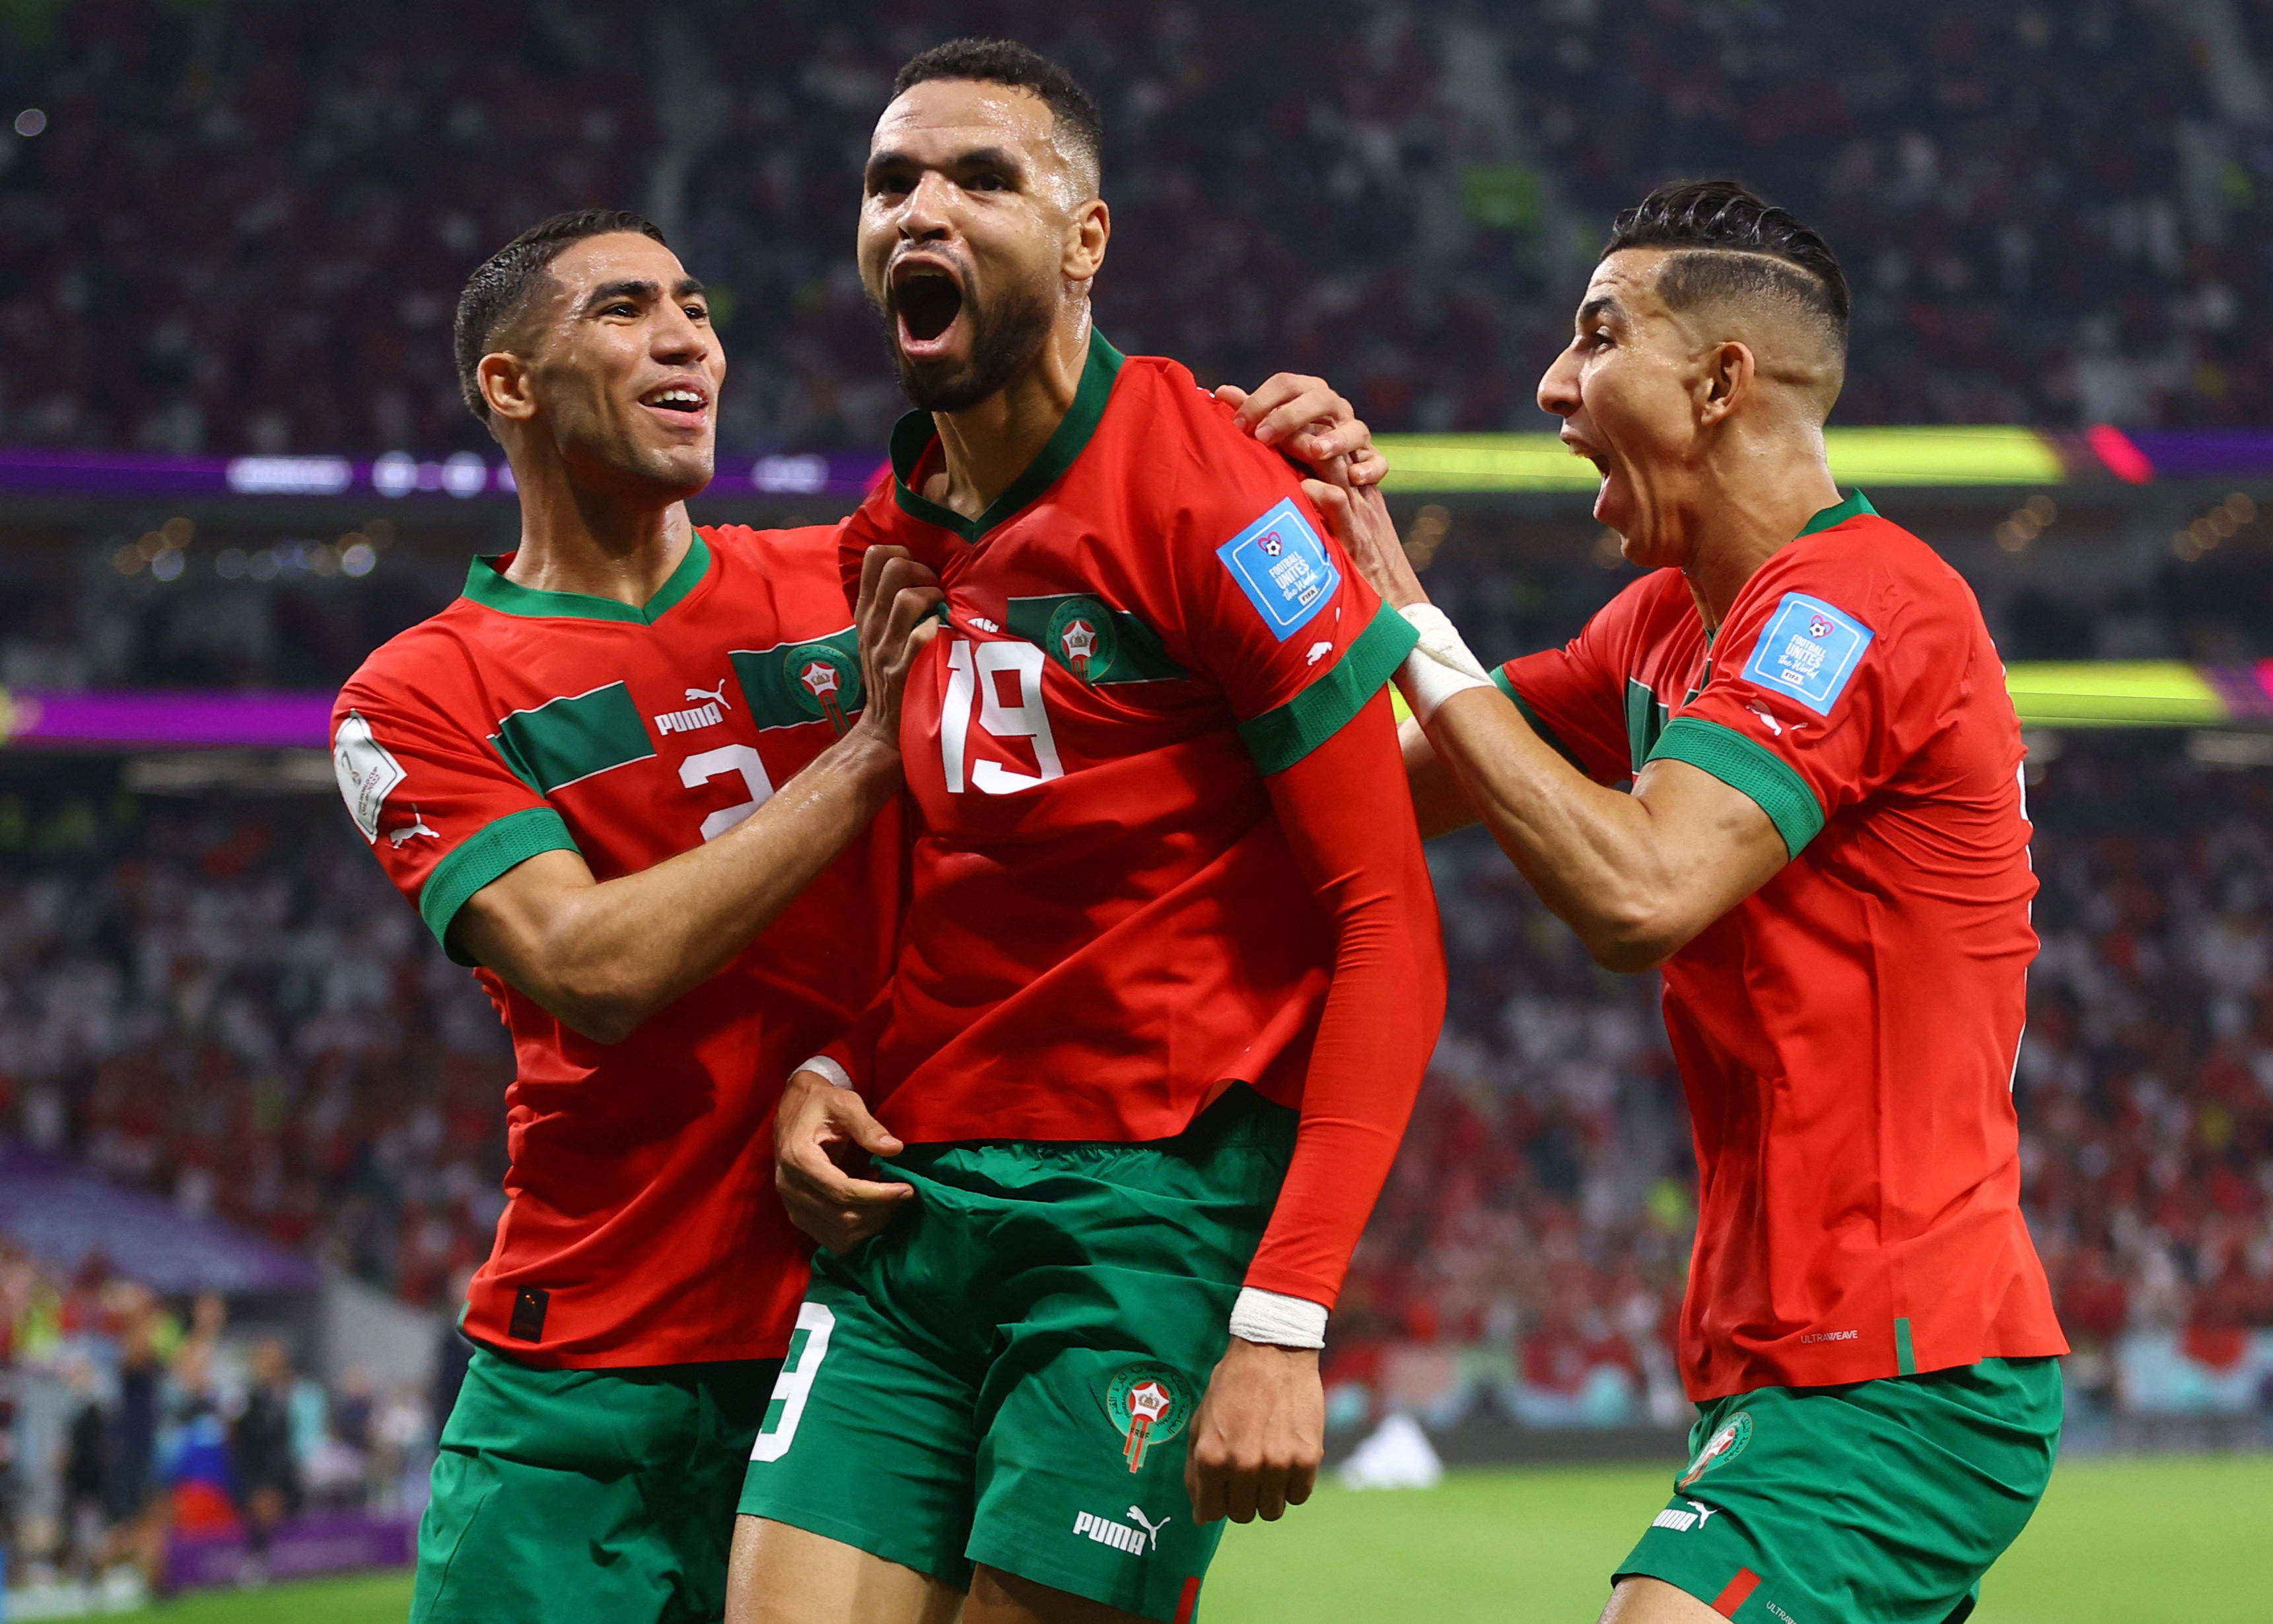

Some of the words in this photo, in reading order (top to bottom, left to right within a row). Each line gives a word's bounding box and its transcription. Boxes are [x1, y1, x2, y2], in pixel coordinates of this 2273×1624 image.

[1269, 551, 1302, 579] FOOTBALL
[1275, 559, 1310, 590] UNITES
[1302, 589, 1315, 602] FIFA
[1786, 642, 1824, 668] UNITES
[1791, 634, 1827, 658] FOOTBALL
[1785, 672, 1800, 682] FIFA
[654, 701, 724, 736] PUMA
[941, 640, 1065, 794] 19
[1801, 1330, 1858, 1344] ULTRAWEAVE
[1072, 1510, 1148, 1556] PUMA
